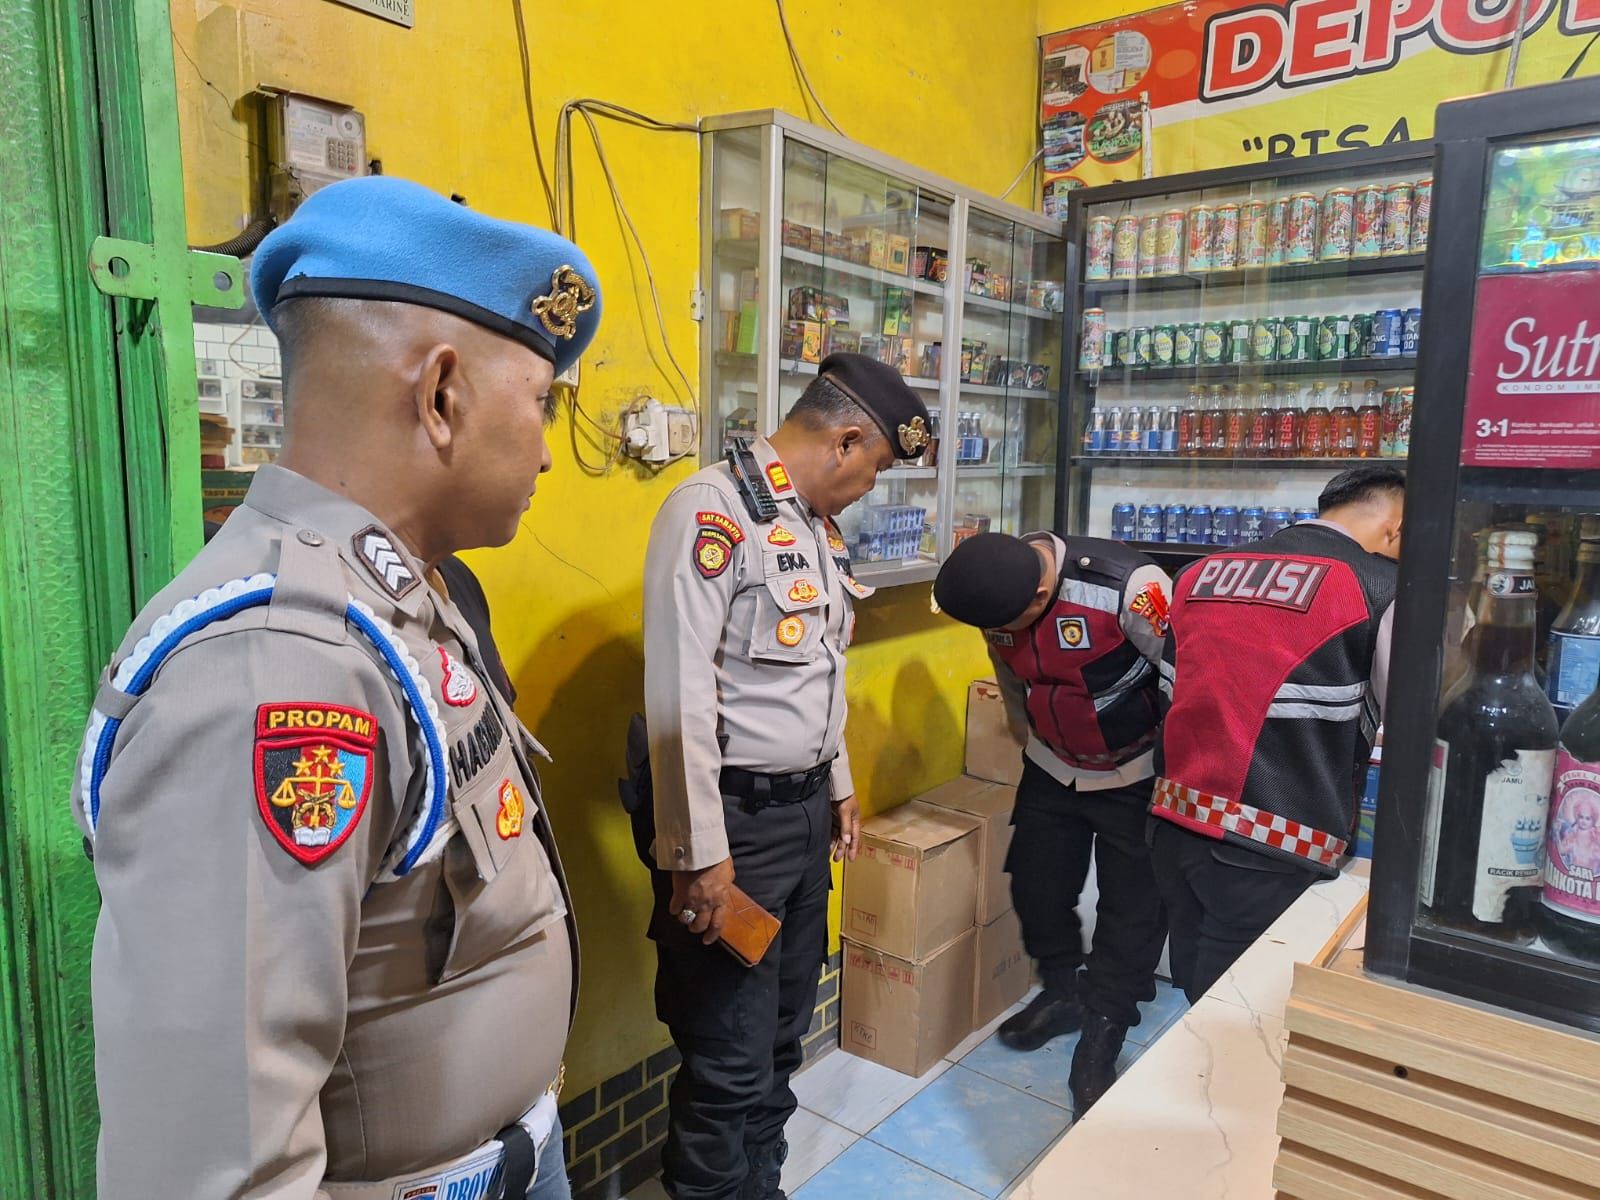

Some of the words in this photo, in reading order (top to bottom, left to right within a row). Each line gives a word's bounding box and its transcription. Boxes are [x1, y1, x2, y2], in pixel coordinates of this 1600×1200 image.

[1200, 0, 1600, 104] DEPO
[1502, 383, 1566, 392] KONDOM
[1475, 418, 1509, 437] 3+1
[777, 552, 809, 571] EKA
[1190, 559, 1321, 606] POLISI
[268, 709, 370, 736] PROPAM
[1501, 777, 1523, 785] JAMU
[1568, 864, 1594, 881] SARI
